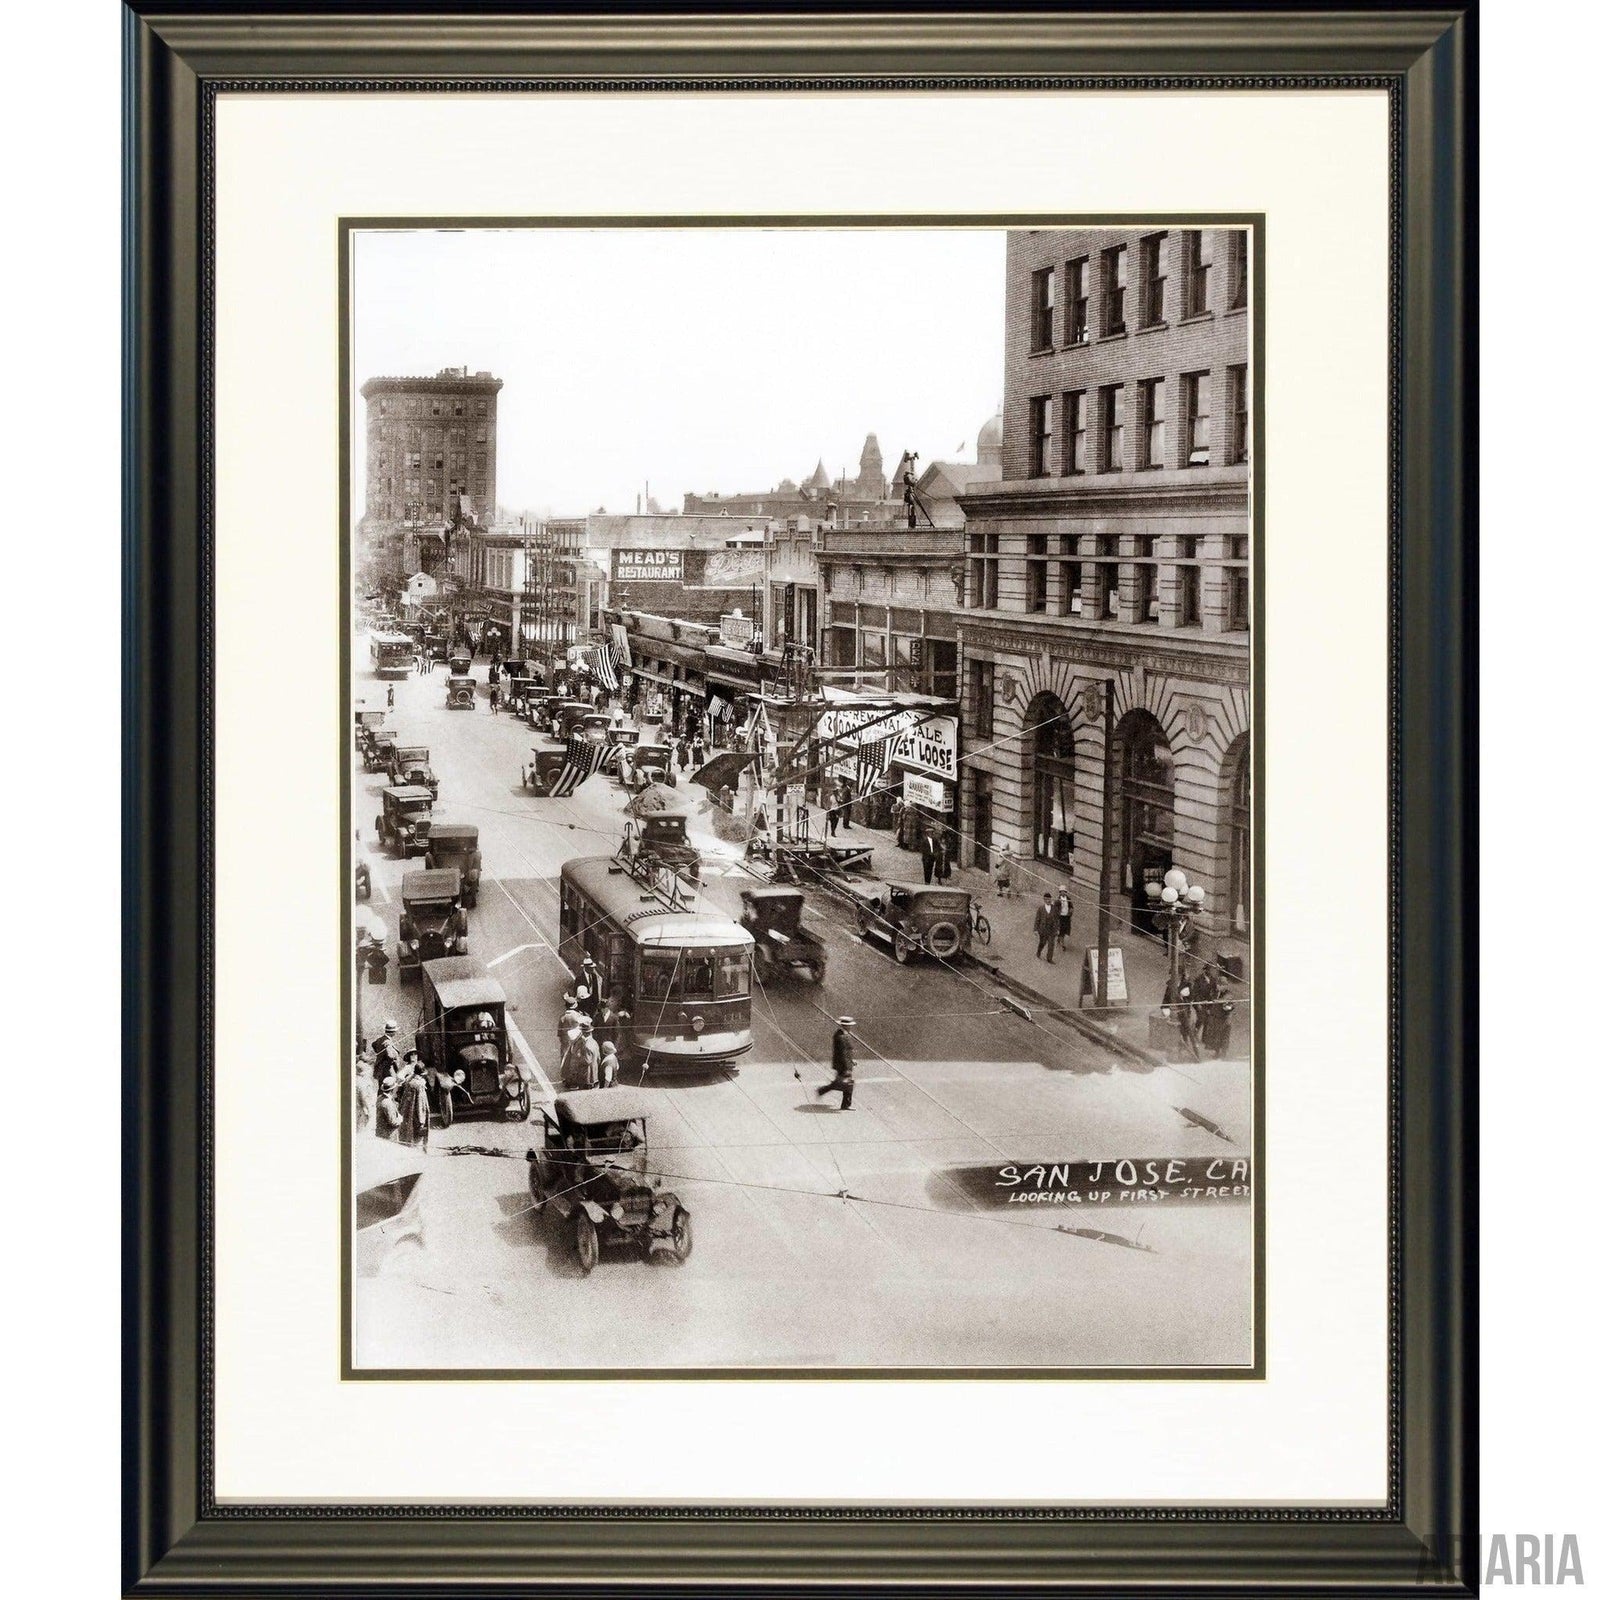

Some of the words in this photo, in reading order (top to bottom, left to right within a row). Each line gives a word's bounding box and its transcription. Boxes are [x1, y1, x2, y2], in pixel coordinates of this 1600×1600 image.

[619, 551, 680, 564] MEAD'S
[618, 566, 681, 578] RESTAURANT
[919, 741, 952, 771] LOOSE
